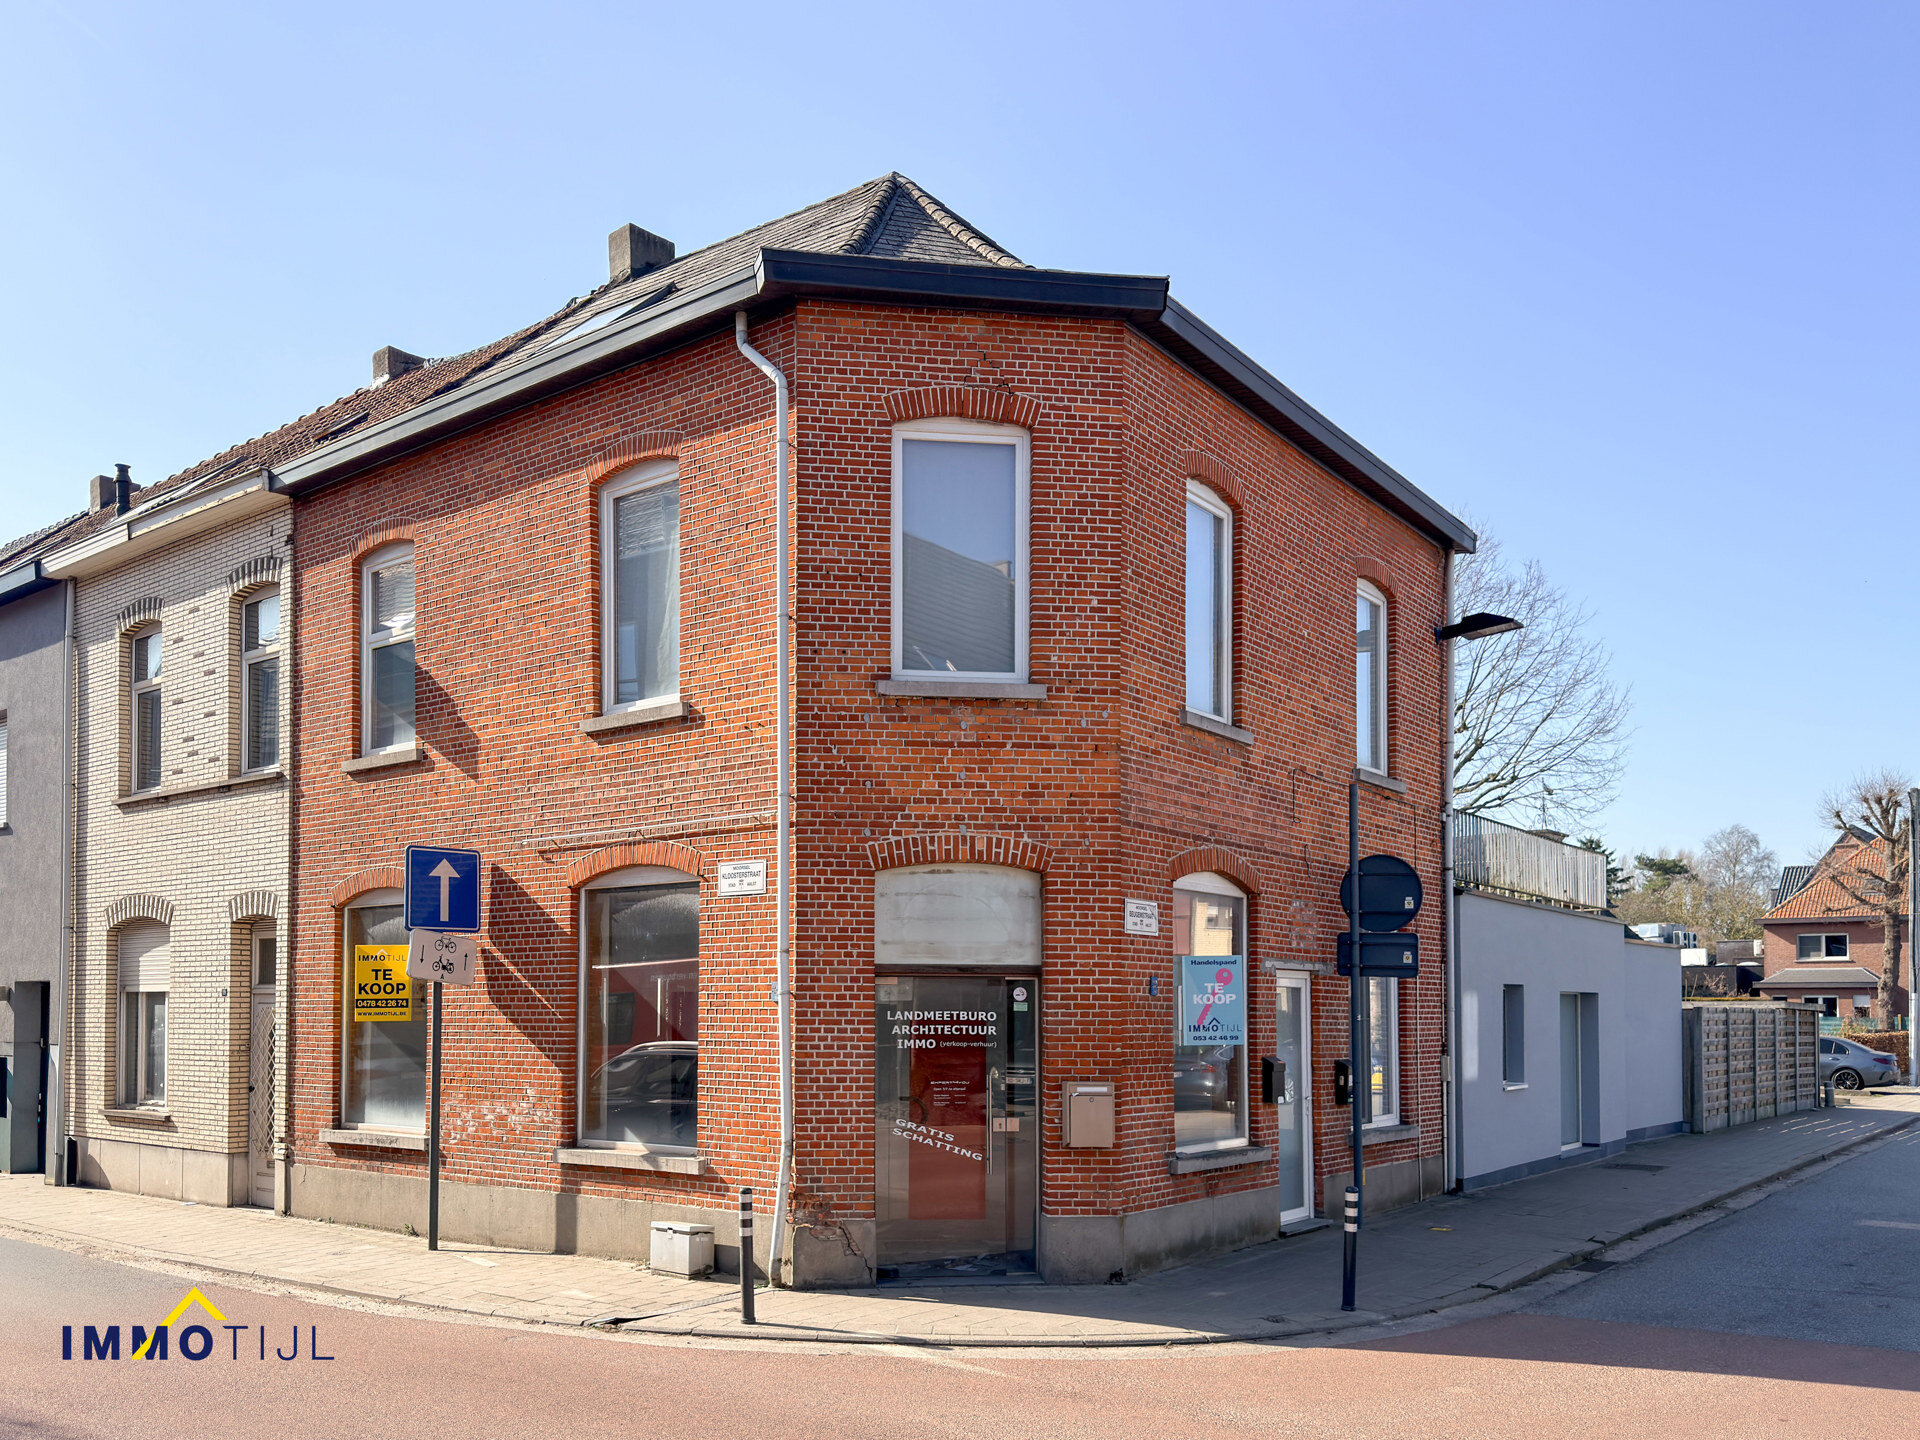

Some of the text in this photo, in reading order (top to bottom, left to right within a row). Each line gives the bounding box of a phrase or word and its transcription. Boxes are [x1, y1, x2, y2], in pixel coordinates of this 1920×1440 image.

[722, 870, 761, 880] KLOOSTERSTRAAT
[371, 968, 393, 980] TE
[358, 982, 406, 995] KOOP
[1204, 982, 1224, 994] TE
[1192, 993, 1236, 1005] KOOP
[887, 1010, 997, 1020] LANDMEETBURO
[892, 1025, 997, 1035] ARCHITECTUUR
[897, 1039, 936, 1049] IMMO
[896, 1118, 954, 1142] GRATIS
[892, 1128, 983, 1161] SCHATTING
